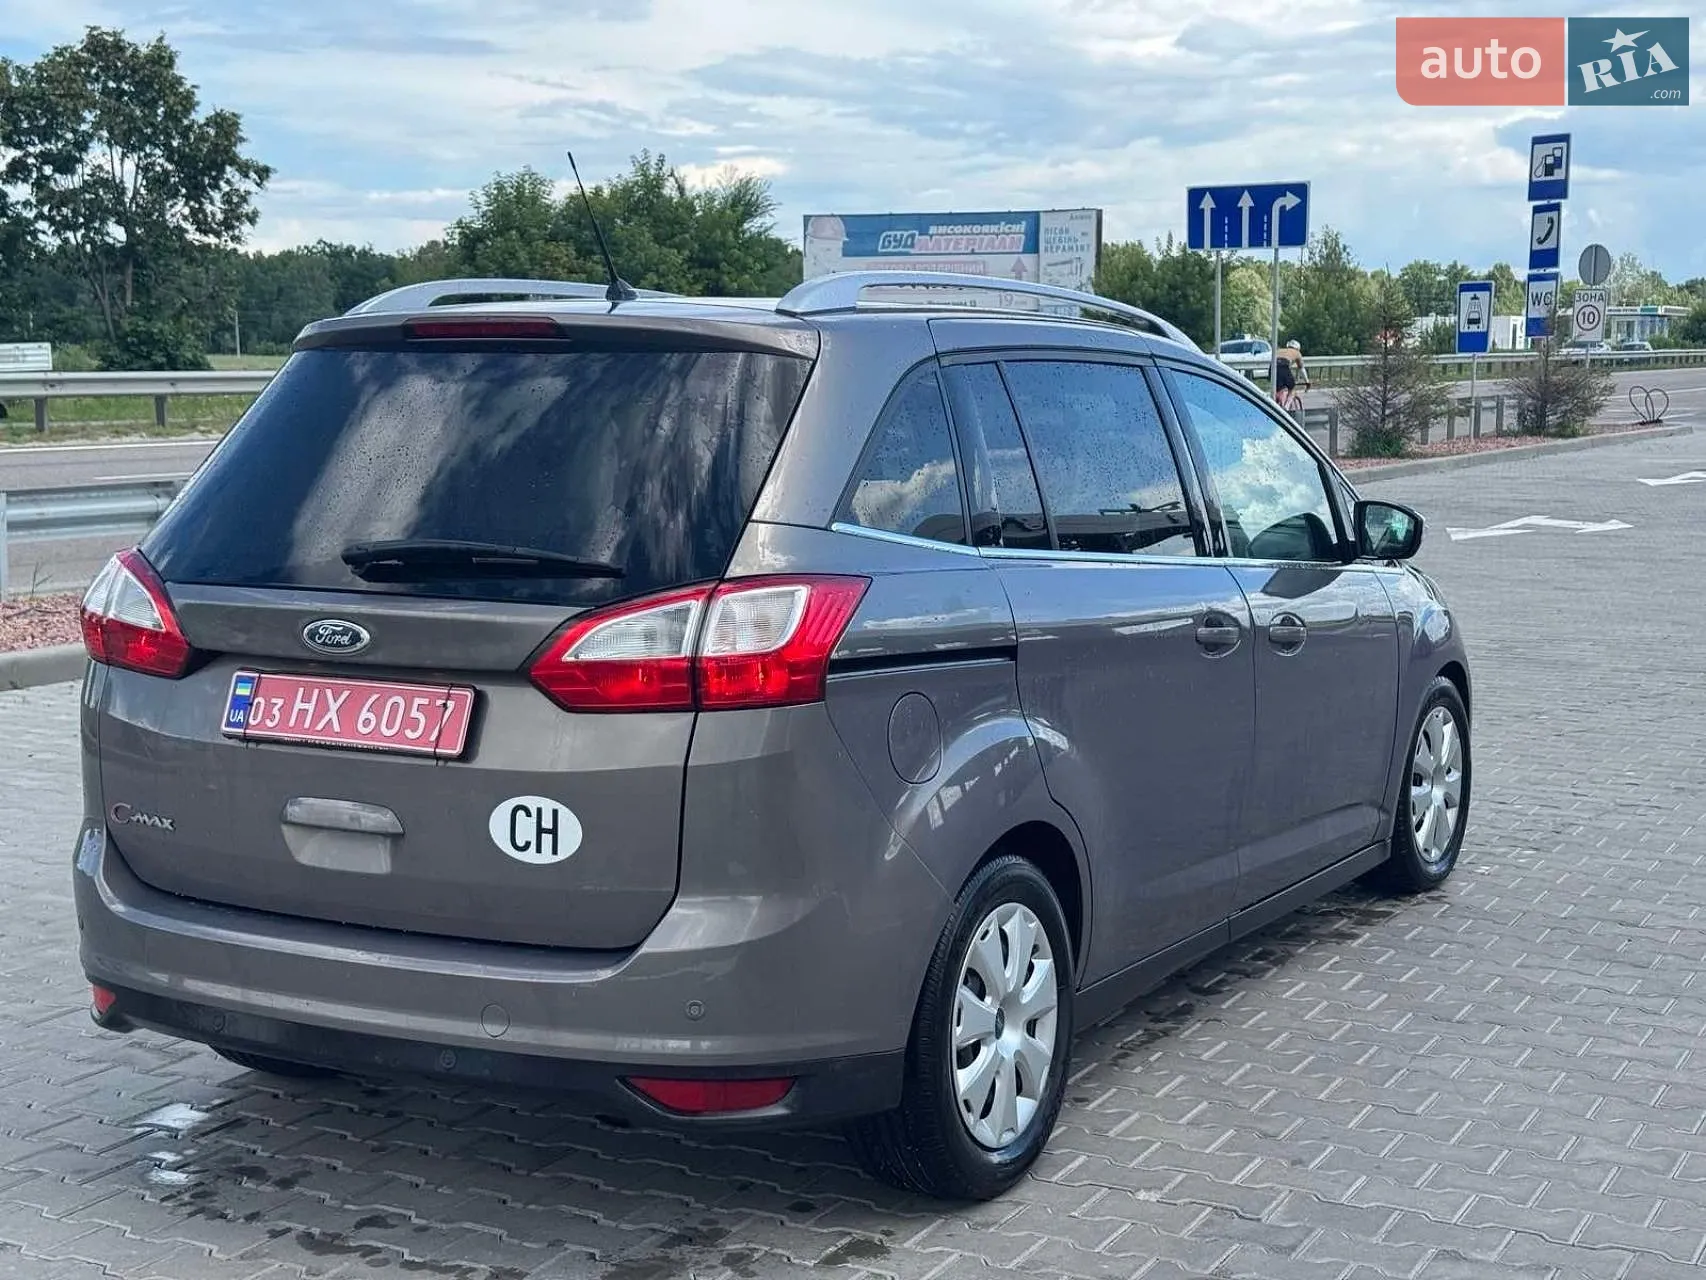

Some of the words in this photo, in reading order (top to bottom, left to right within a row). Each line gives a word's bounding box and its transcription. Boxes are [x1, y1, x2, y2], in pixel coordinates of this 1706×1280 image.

[1531, 292, 1553, 306] WC
[1576, 292, 1605, 303] ЗОНА
[1581, 311, 1596, 325] 10
[315, 624, 353, 646] Ford
[230, 709, 244, 723] UA
[249, 696, 285, 728] 03
[357, 693, 456, 742] 6057
[509, 803, 559, 855] CH
